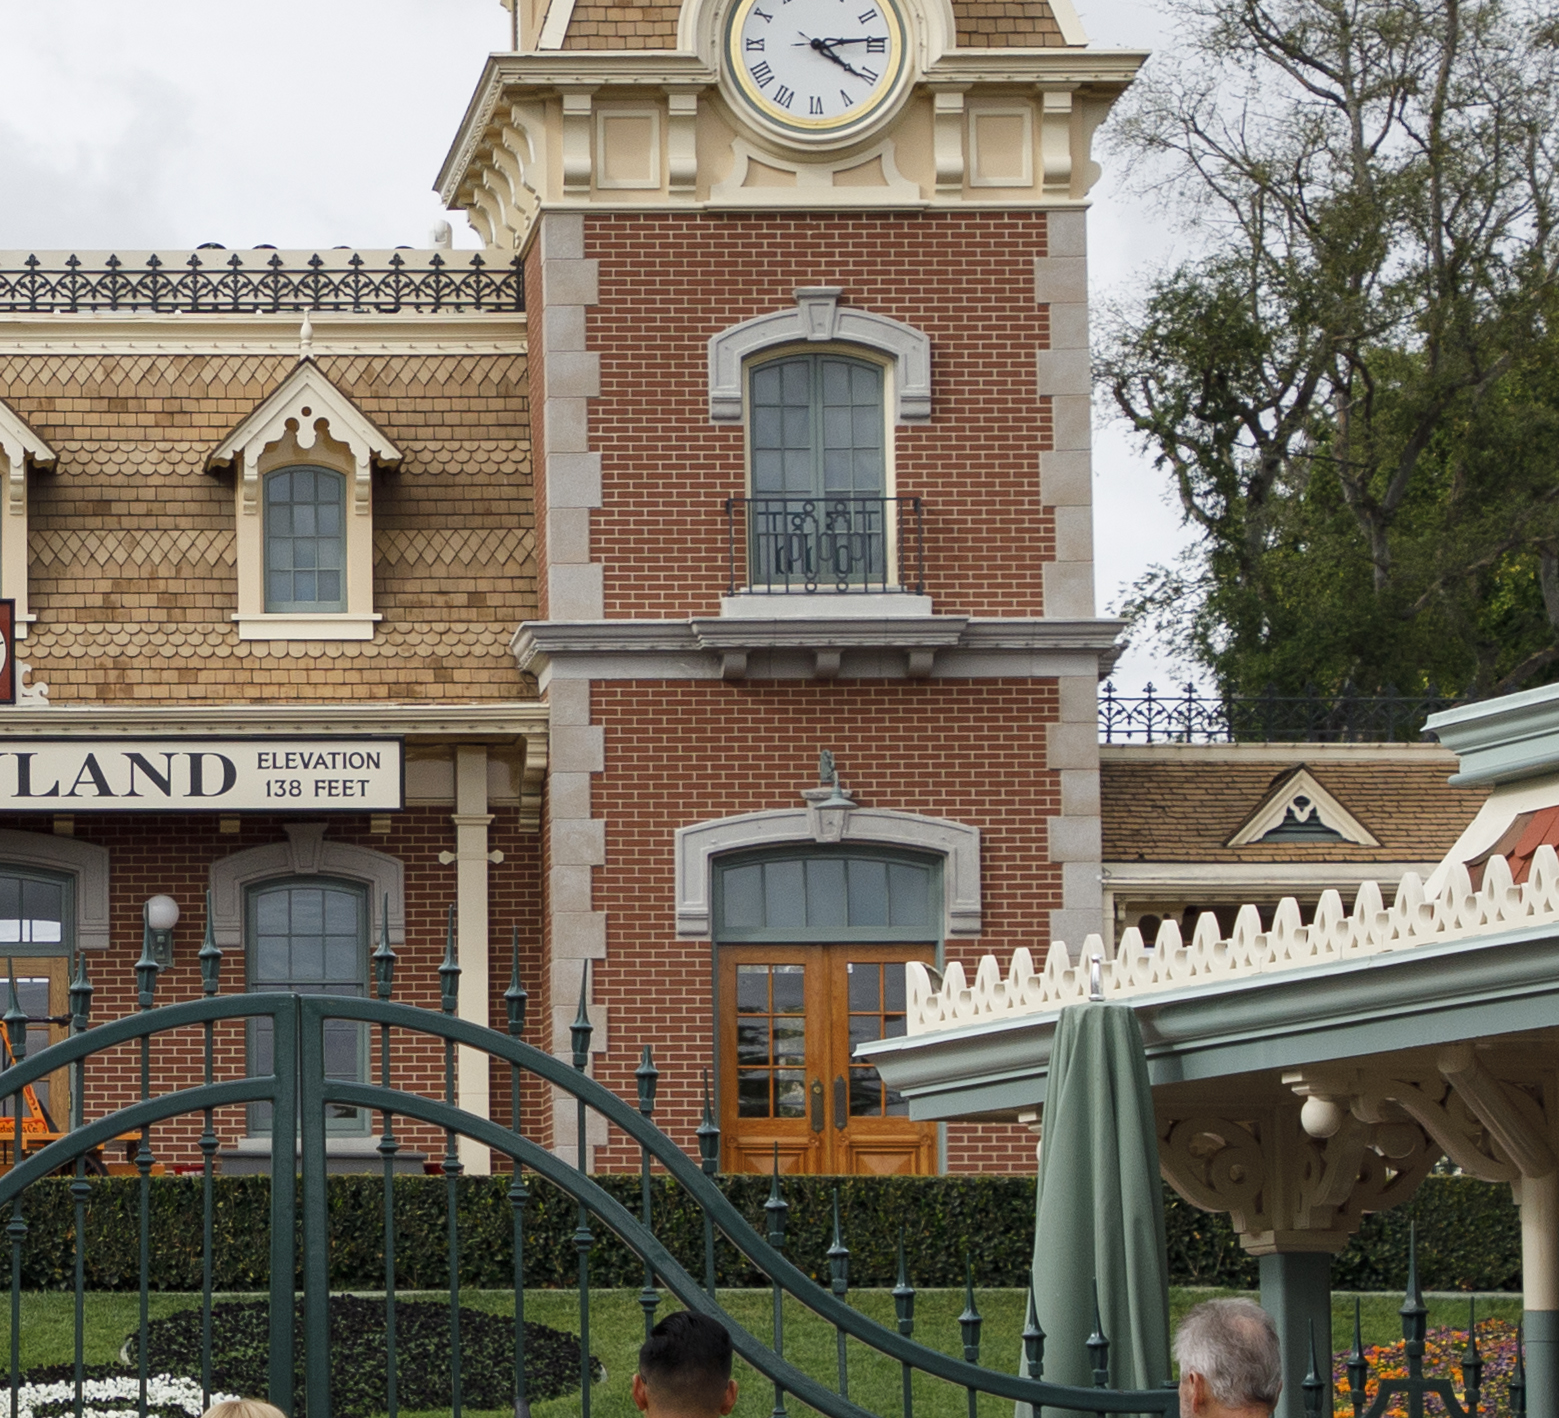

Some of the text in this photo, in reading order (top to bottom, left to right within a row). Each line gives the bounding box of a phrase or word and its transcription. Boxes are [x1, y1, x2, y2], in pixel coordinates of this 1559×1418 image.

[753, 7, 774, 24] X
[858, 8, 878, 25] II
[746, 37, 765, 52] IX
[749, 60, 775, 89] VIII
[773, 84, 795, 109] VII
[809, 96, 824, 115] VI
[840, 89, 854, 108] V
[257, 752, 381, 770] ELEVATION
[266, 779, 370, 798] 138 FEET
